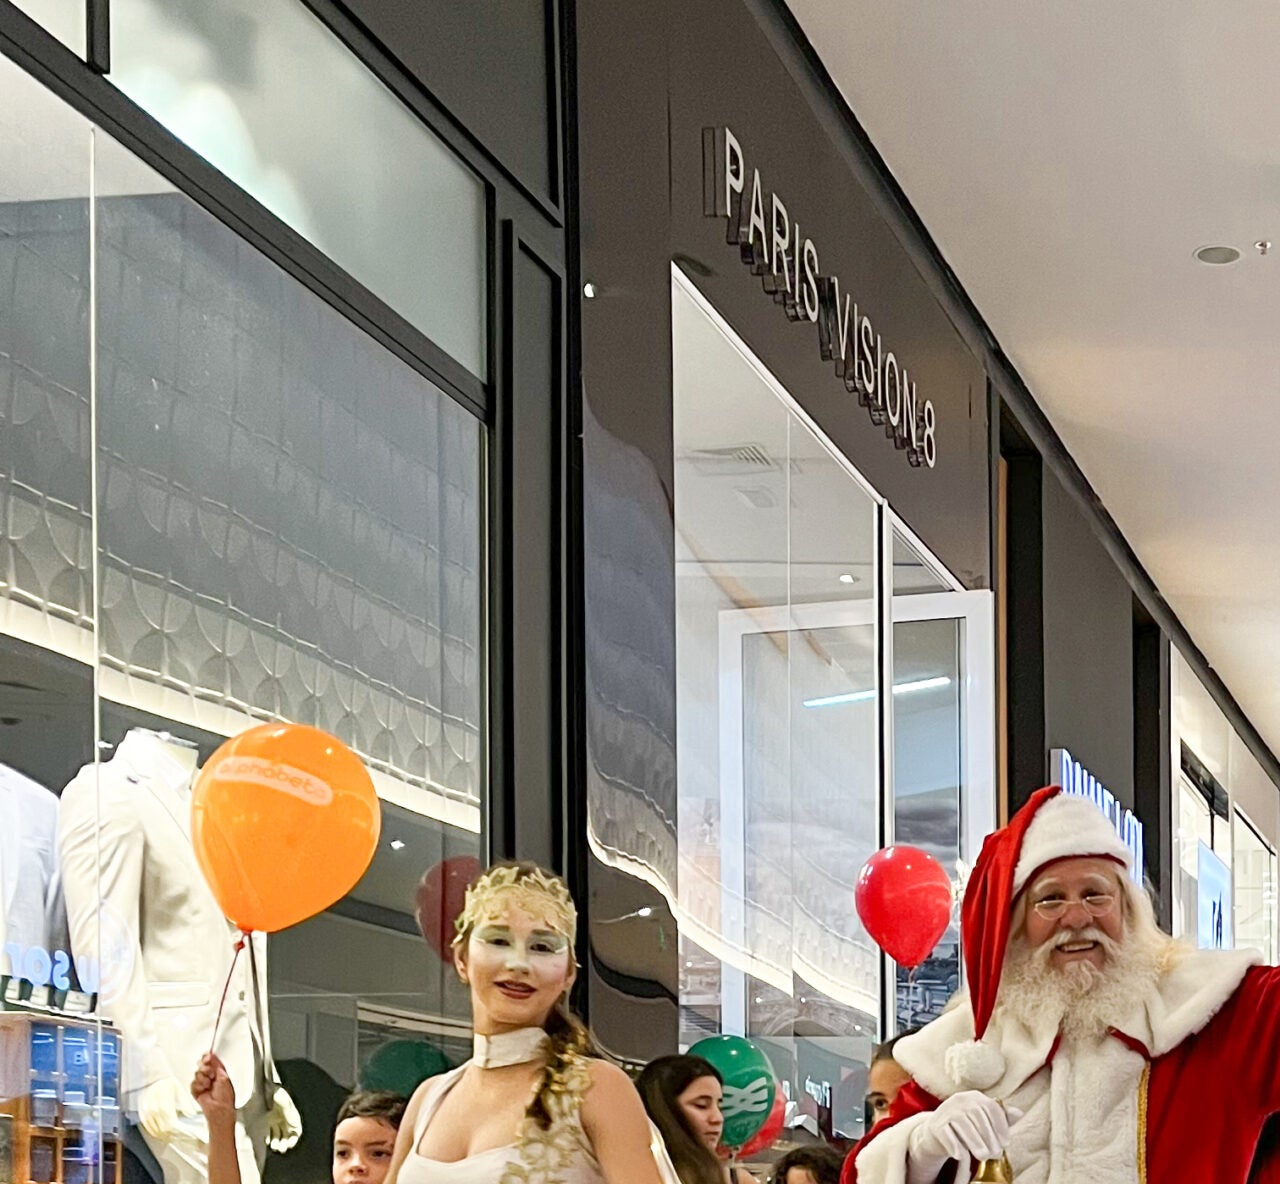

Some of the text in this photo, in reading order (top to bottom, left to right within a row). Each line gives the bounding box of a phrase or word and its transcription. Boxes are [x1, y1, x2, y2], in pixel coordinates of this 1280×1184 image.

[726, 127, 820, 323] PARIS
[831, 275, 918, 450] VISION
[219, 762, 327, 799] aphabeto
